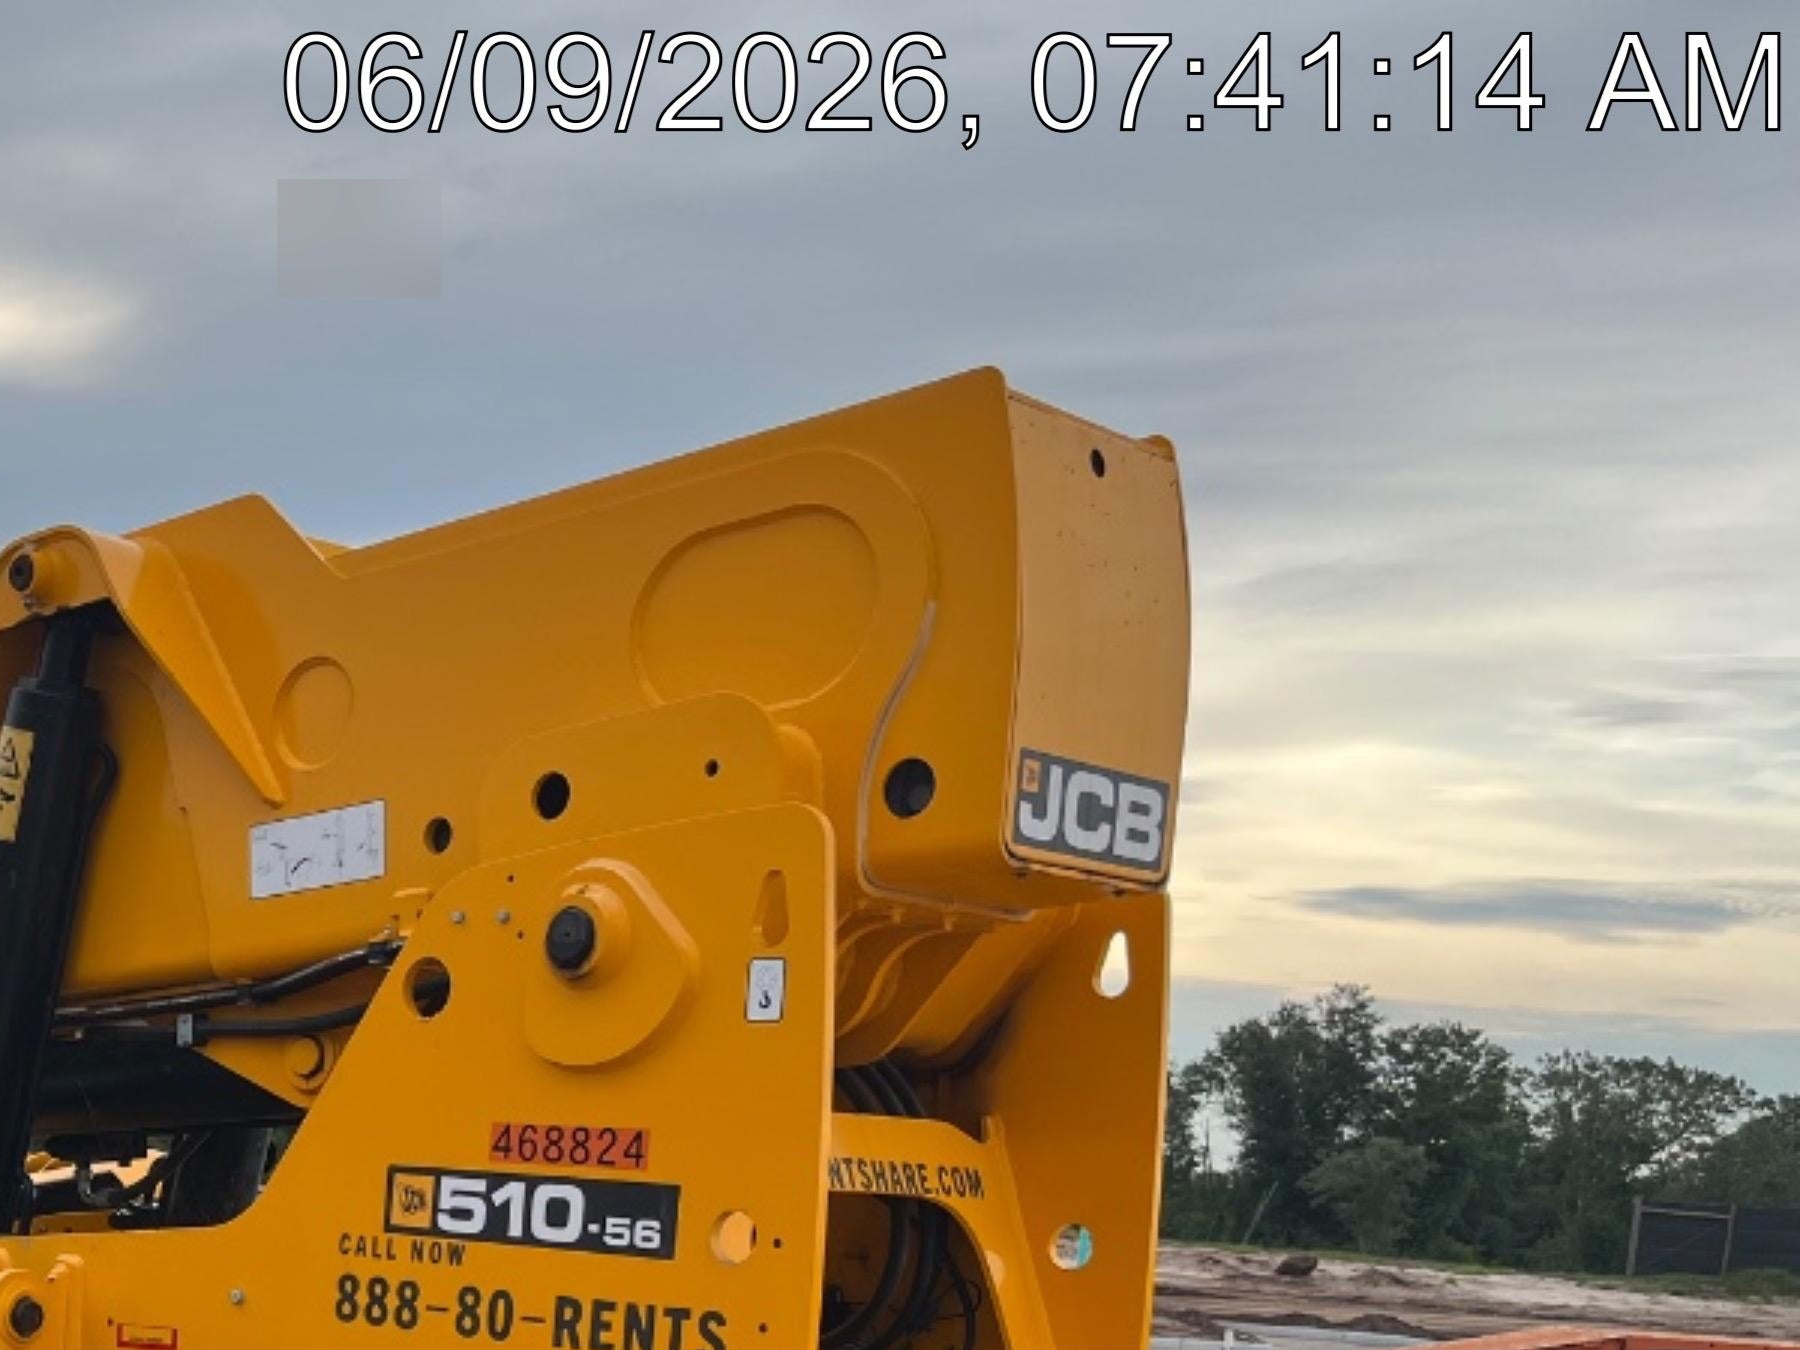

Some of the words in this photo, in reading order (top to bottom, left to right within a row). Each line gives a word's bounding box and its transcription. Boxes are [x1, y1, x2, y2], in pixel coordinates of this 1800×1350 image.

[1018, 763, 1163, 863] JCB
[491, 1123, 645, 1168] 468824
[829, 1157, 985, 1199] NTSHARE.COM
[436, 1174, 662, 1250] 510-56
[338, 1232, 398, 1262] CALL
[410, 1239, 466, 1267] NOW
